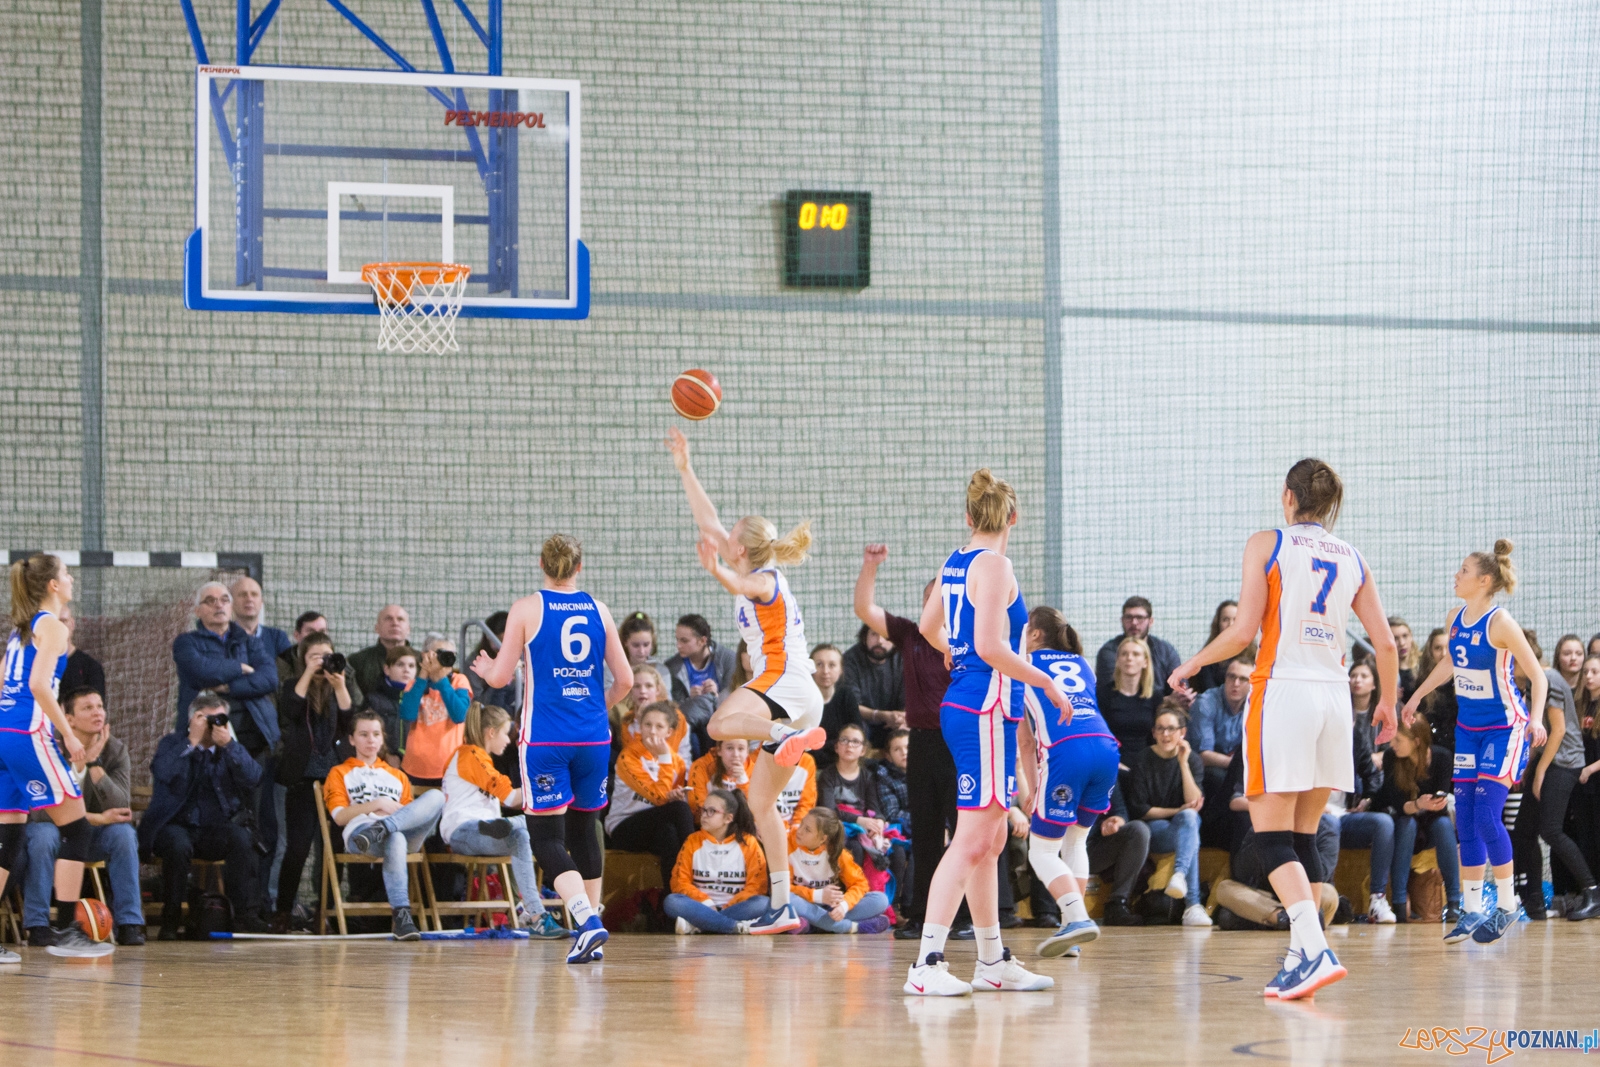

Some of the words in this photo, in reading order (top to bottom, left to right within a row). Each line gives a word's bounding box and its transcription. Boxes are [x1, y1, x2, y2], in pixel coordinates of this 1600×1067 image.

[444, 109, 546, 129] PESMENPOL
[1310, 556, 1338, 616] 7
[548, 602, 595, 611] MARCINIAK
[941, 583, 965, 639] 17
[560, 615, 592, 663] 6
[1455, 645, 1469, 667] 3
[1048, 661, 1086, 693] 8
[1458, 679, 1484, 691] Enea
